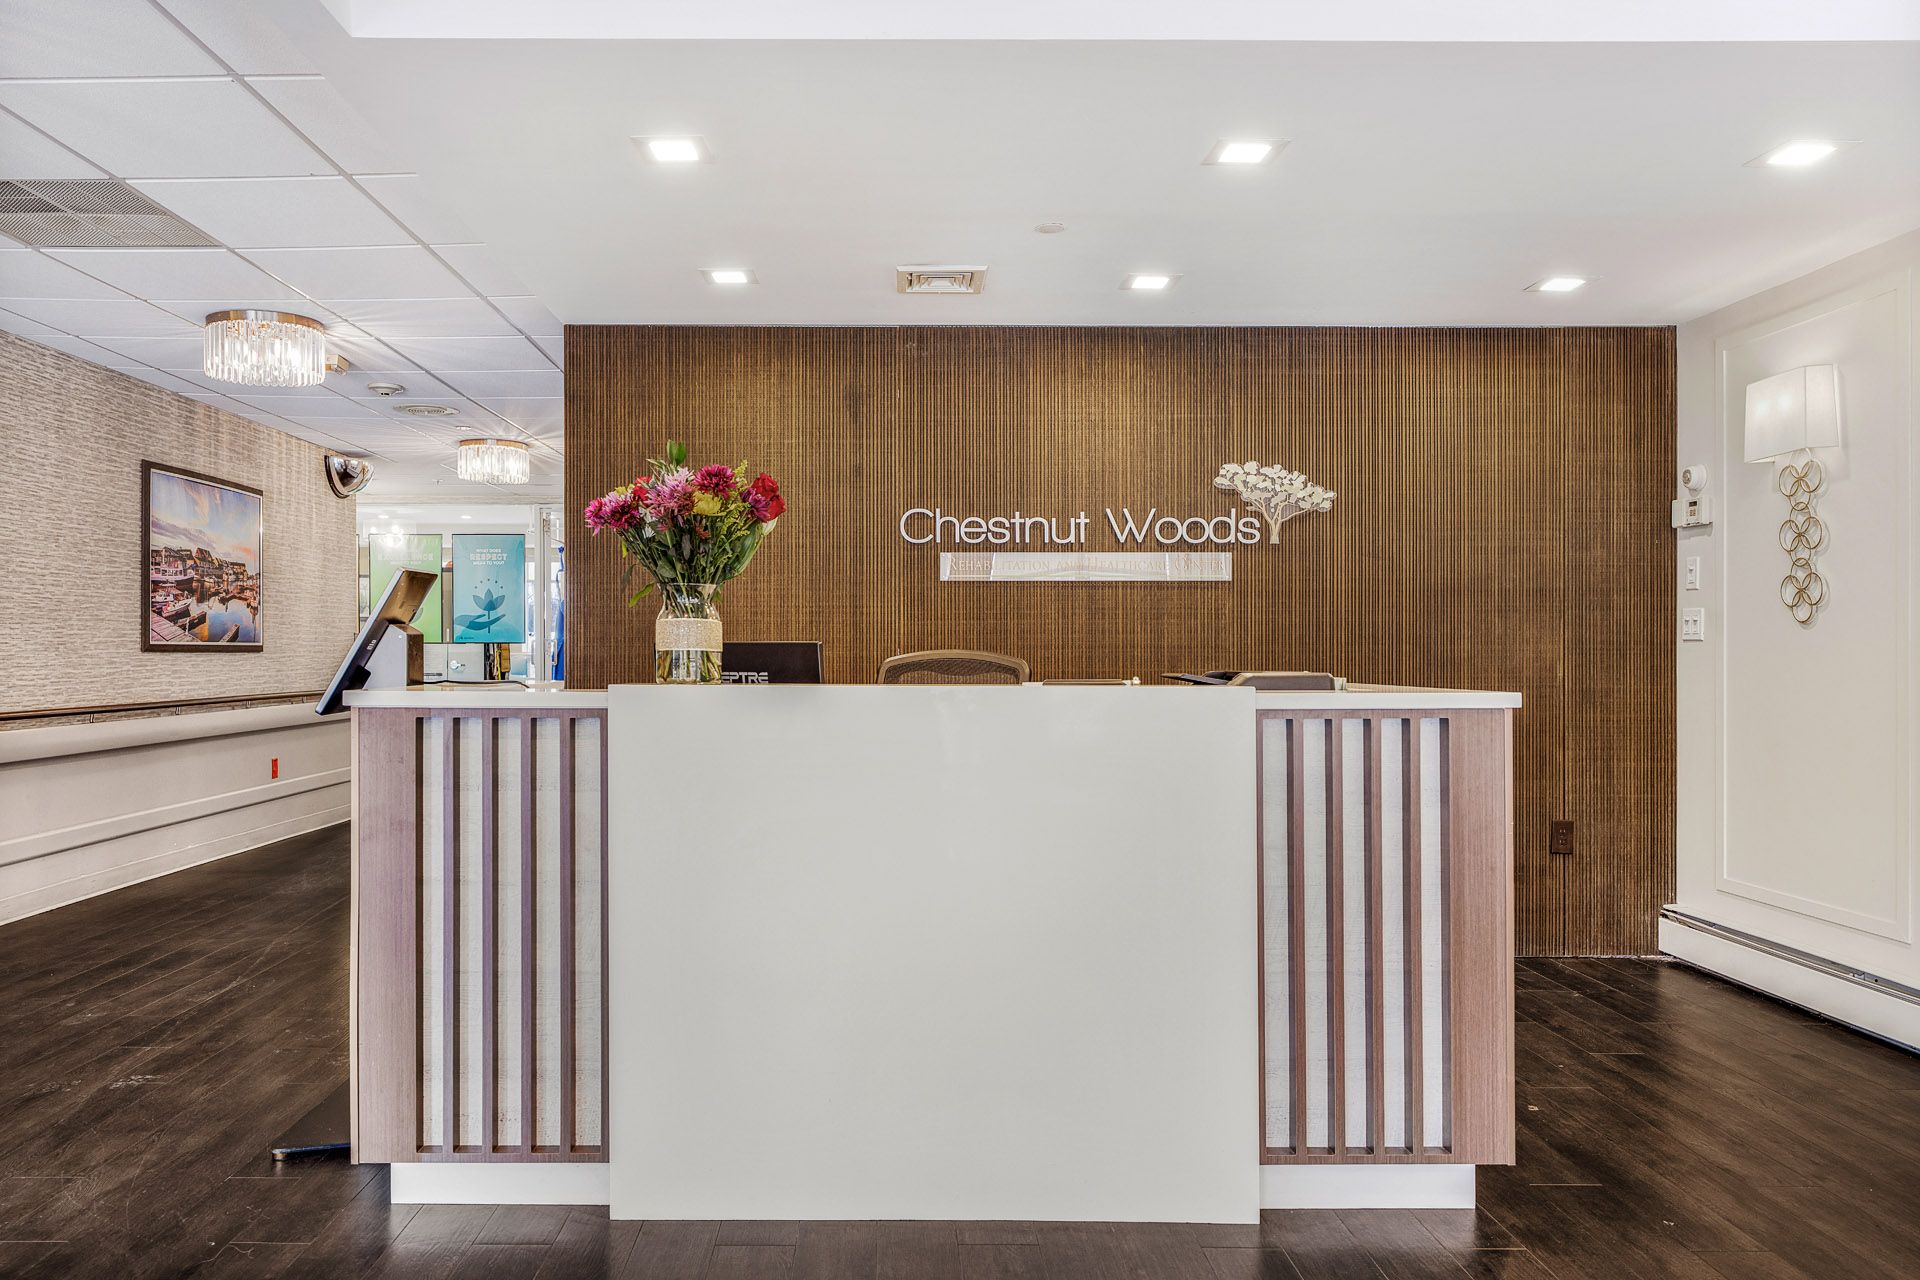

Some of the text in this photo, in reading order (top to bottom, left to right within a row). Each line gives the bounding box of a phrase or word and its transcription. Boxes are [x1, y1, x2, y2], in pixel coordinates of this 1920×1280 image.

[899, 508, 1261, 544] Chestnut Woods
[470, 553, 508, 561] RESPECT
[721, 671, 769, 684] EPTRE
